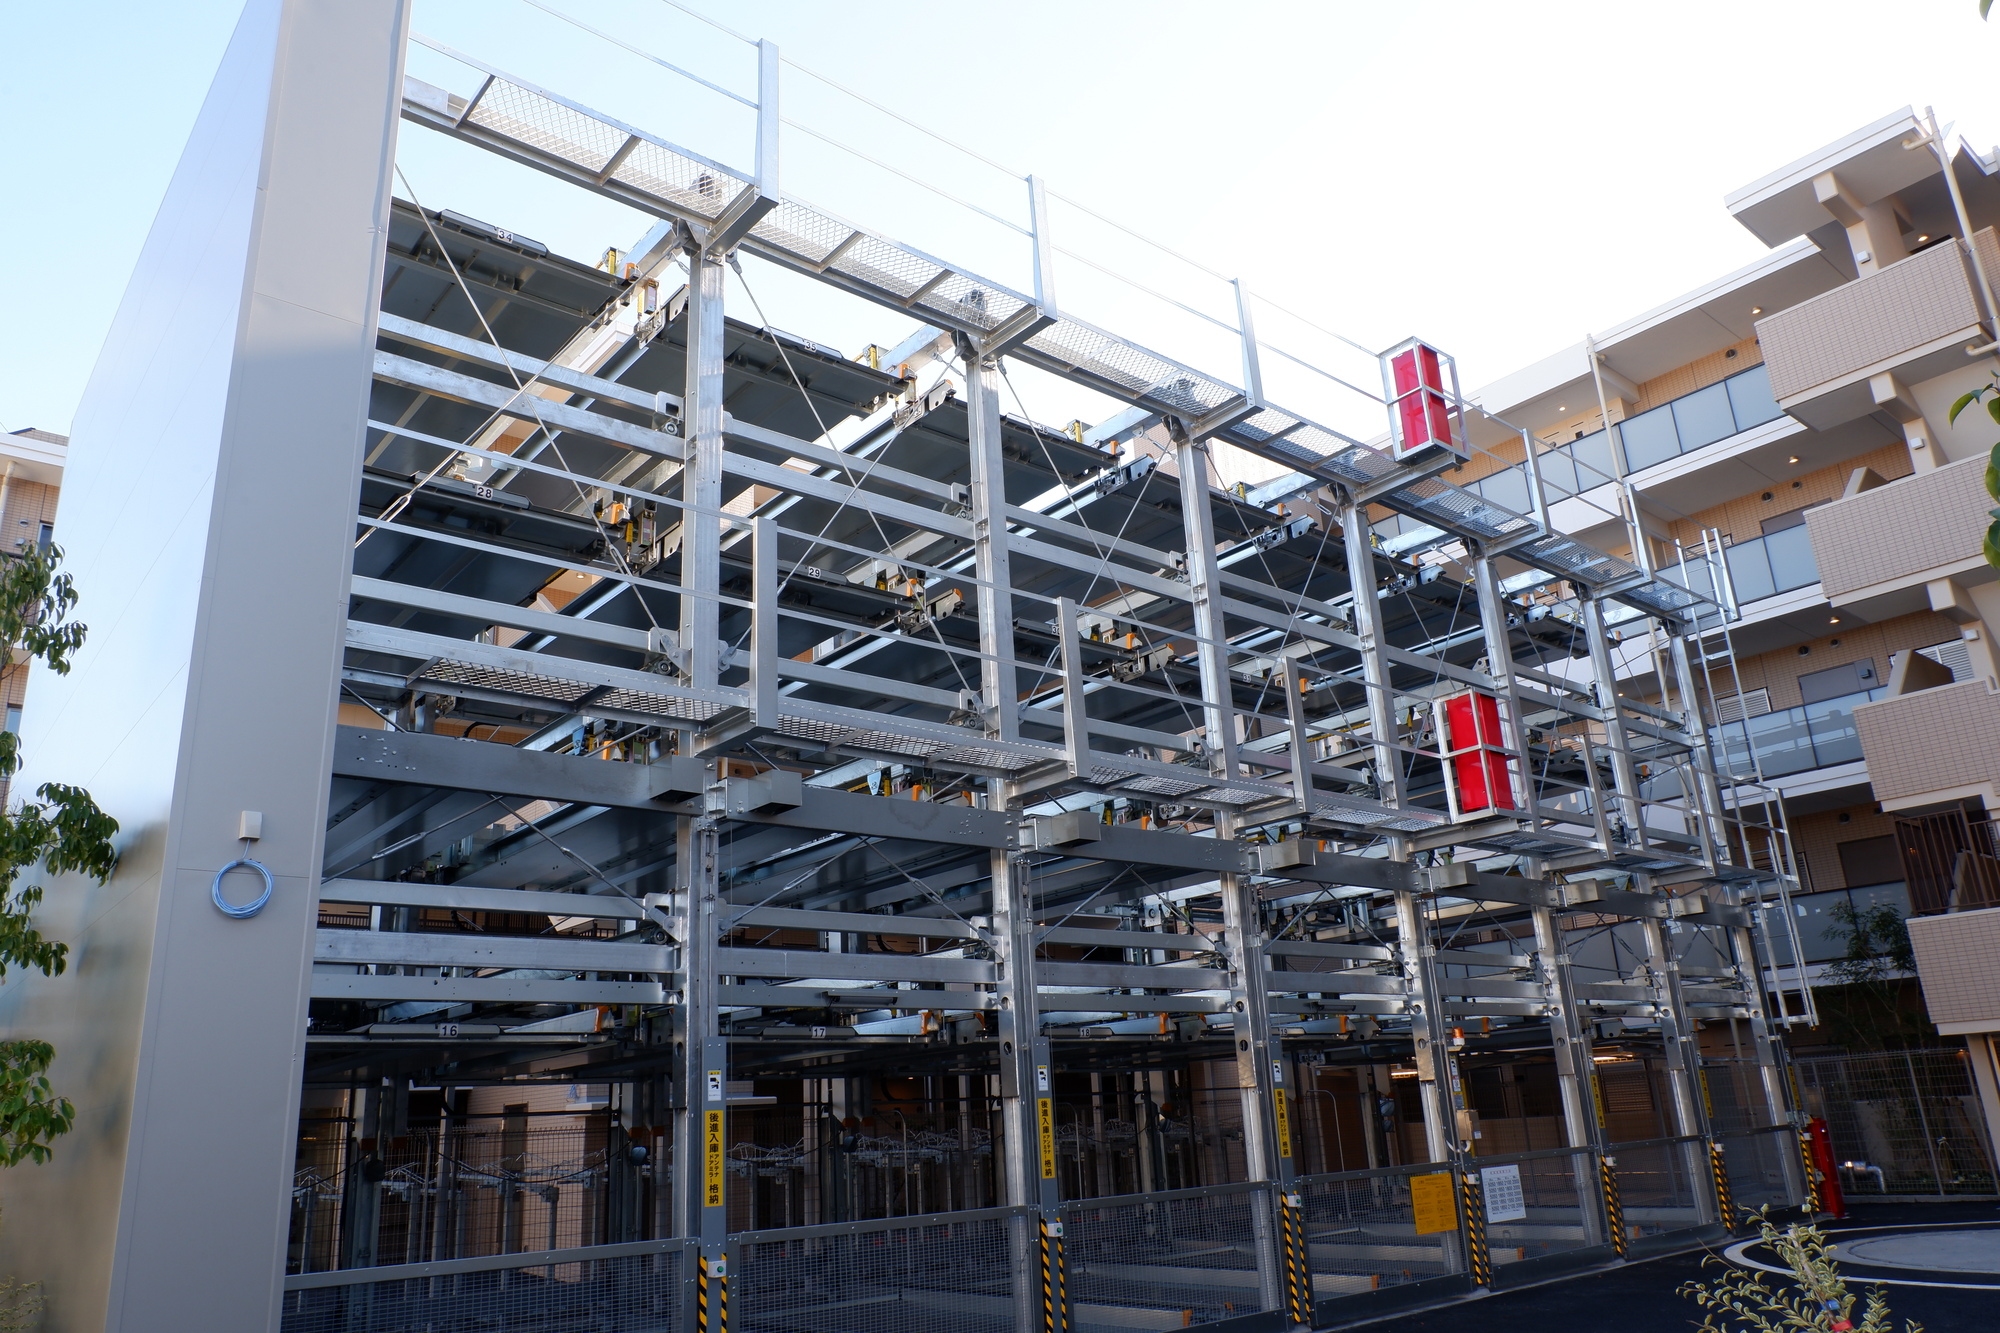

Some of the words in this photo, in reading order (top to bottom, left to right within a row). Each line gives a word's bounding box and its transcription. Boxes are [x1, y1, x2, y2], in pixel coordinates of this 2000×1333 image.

[499, 230, 512, 242] 34
[806, 341, 816, 351] 35
[477, 487, 492, 498] 28
[810, 567, 820, 577] 29
[442, 1025, 457, 1036] 16
[814, 1028, 825, 1037] 17
[1081, 1029, 1089, 1037] 18
[1041, 1100, 1050, 1134] 後進入庫
[708, 1112, 719, 1153] 後進入庫
[1044, 1160, 1052, 1176] 格納
[708, 1184, 719, 1204] 格納
